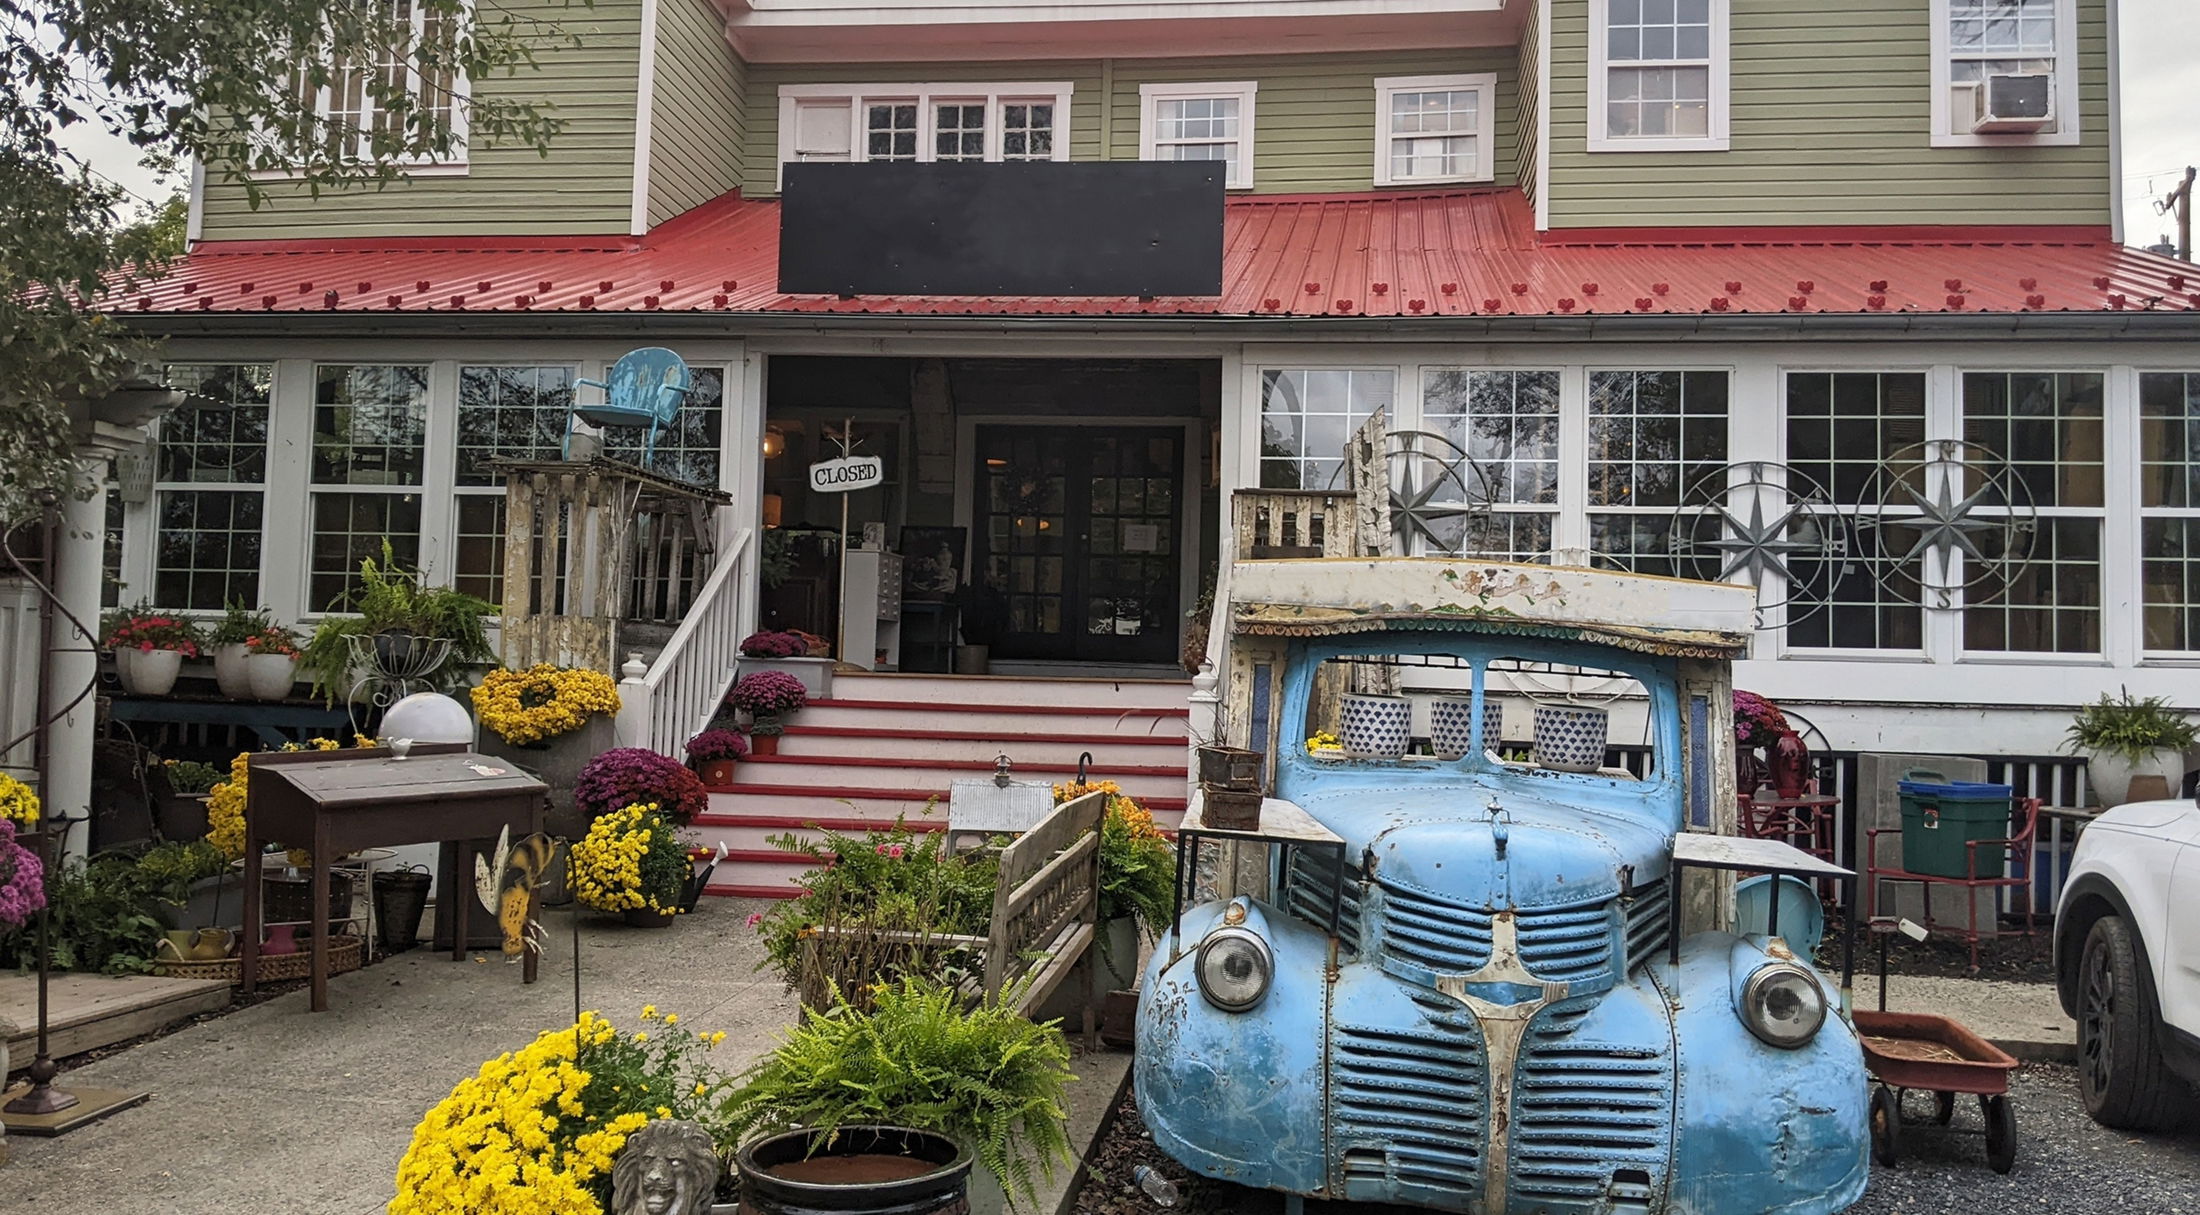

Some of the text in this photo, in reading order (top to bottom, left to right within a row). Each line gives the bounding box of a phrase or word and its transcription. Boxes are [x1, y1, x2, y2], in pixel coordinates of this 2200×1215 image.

[1938, 440, 1955, 462] N
[815, 464, 877, 486] CLOSED
[1749, 462, 1764, 484] N
[1856, 514, 1879, 530] W
[1936, 588, 1951, 610] S
